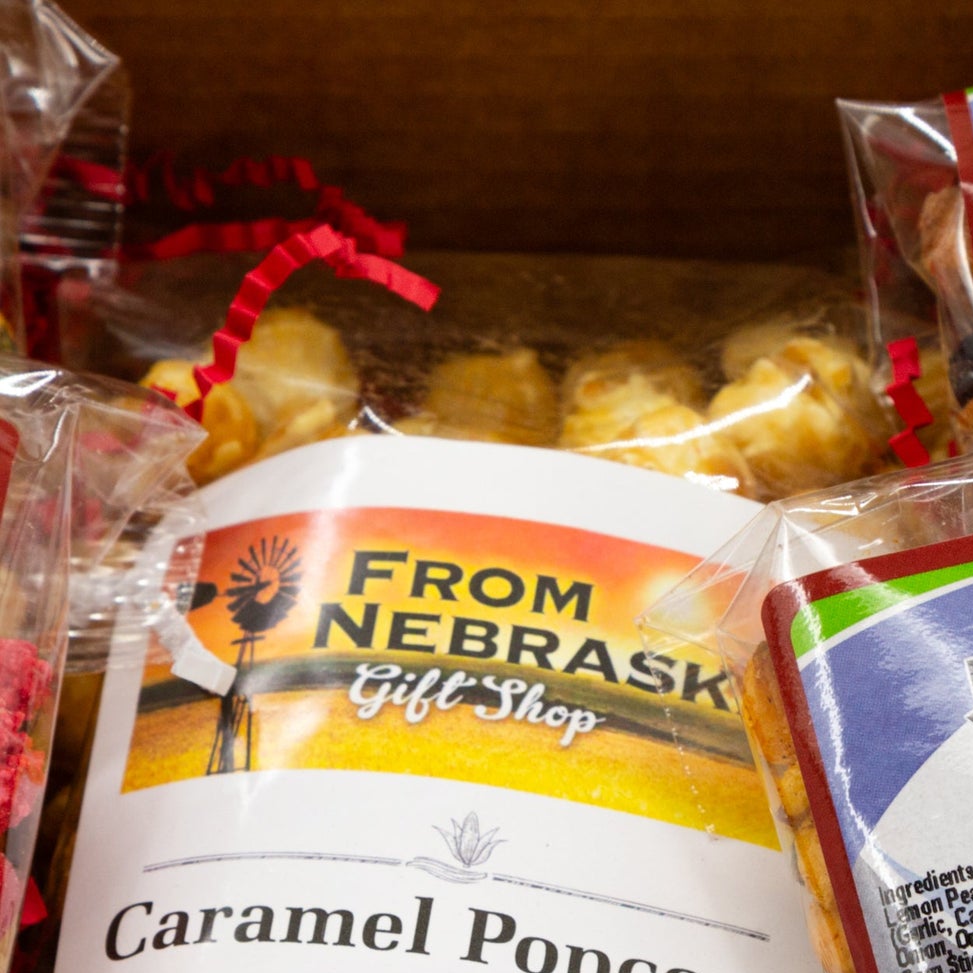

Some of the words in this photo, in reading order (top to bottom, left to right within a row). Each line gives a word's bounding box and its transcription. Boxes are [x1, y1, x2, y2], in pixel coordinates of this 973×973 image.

[346, 549, 594, 622] FROM
[348, 662, 477, 724] Gift
[474, 674, 606, 748] Shop
[104, 897, 431, 961] Caramel
